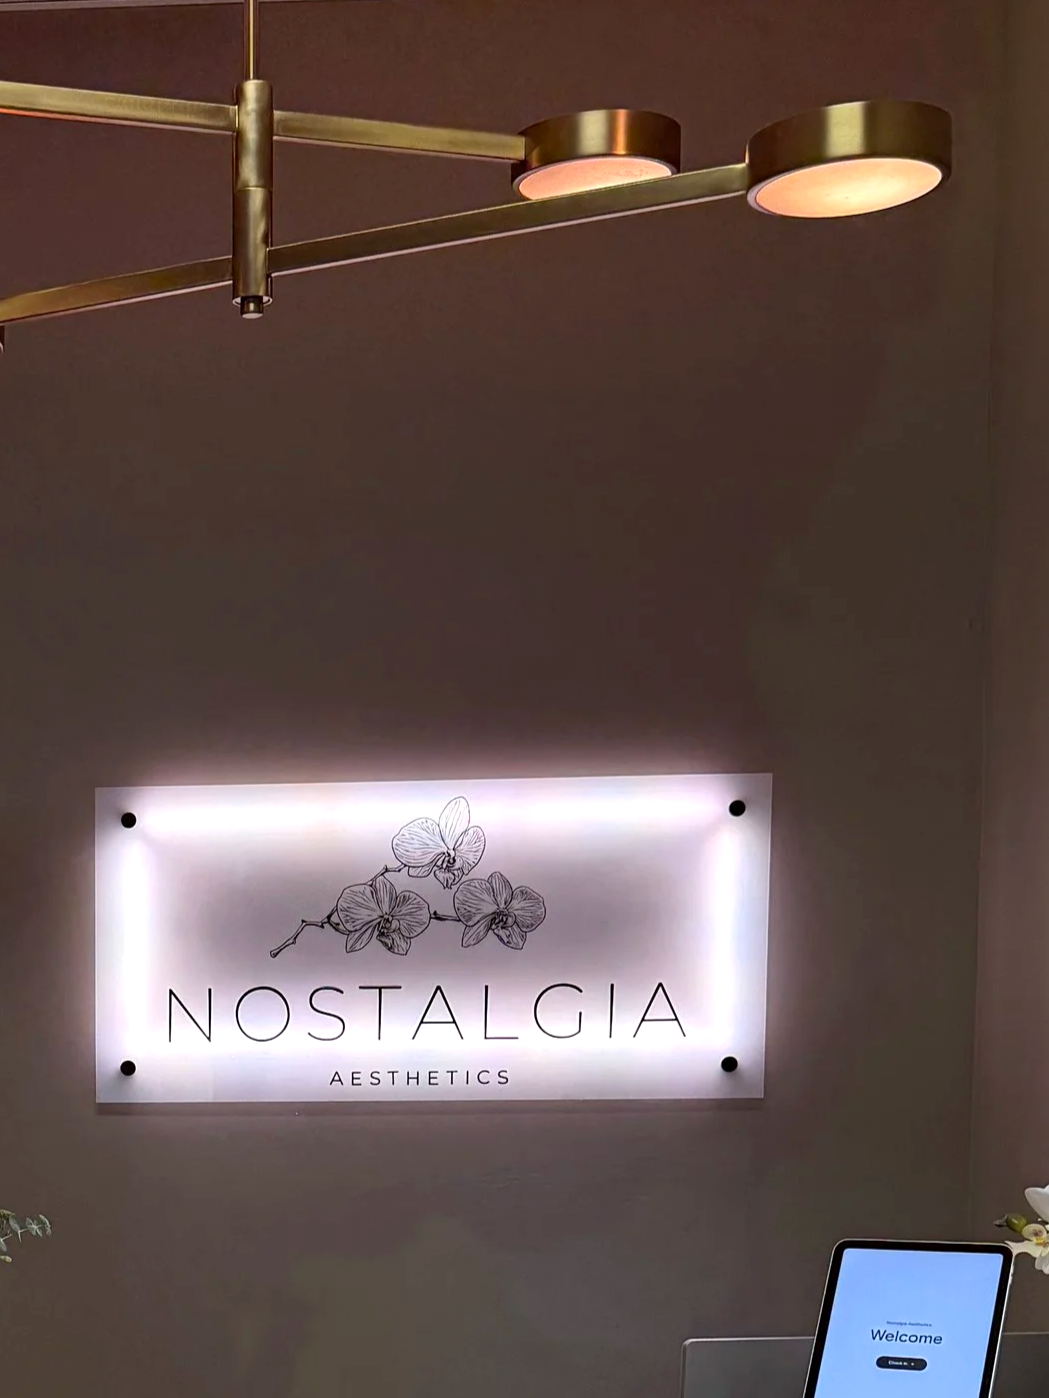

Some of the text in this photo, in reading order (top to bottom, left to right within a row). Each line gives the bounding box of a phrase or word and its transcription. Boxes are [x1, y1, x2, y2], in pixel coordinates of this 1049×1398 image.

[168, 981, 686, 1043] NOSTALGIA
[329, 1069, 511, 1087] AESTHETICS
[871, 1328, 943, 1345] Welcome
